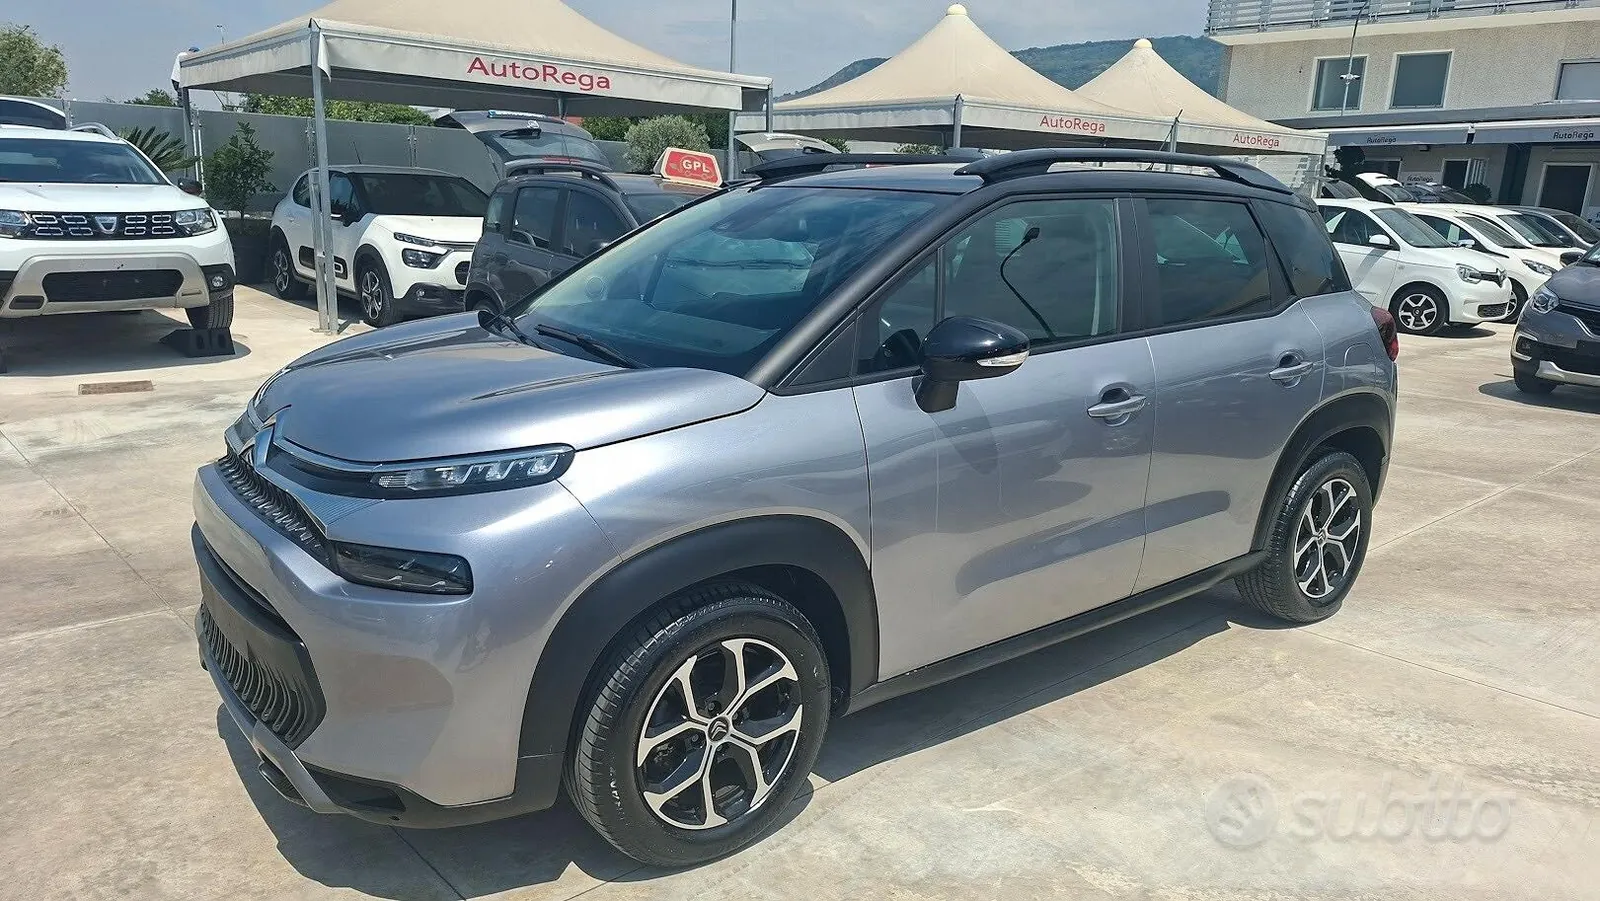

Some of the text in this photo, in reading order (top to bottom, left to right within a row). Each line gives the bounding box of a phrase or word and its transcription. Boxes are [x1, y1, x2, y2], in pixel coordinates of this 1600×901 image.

[467, 57, 611, 91] AutoRega
[1040, 116, 1105, 134] AutoRega
[1233, 133, 1280, 149] AutoRega
[682, 159, 710, 173] GPL
